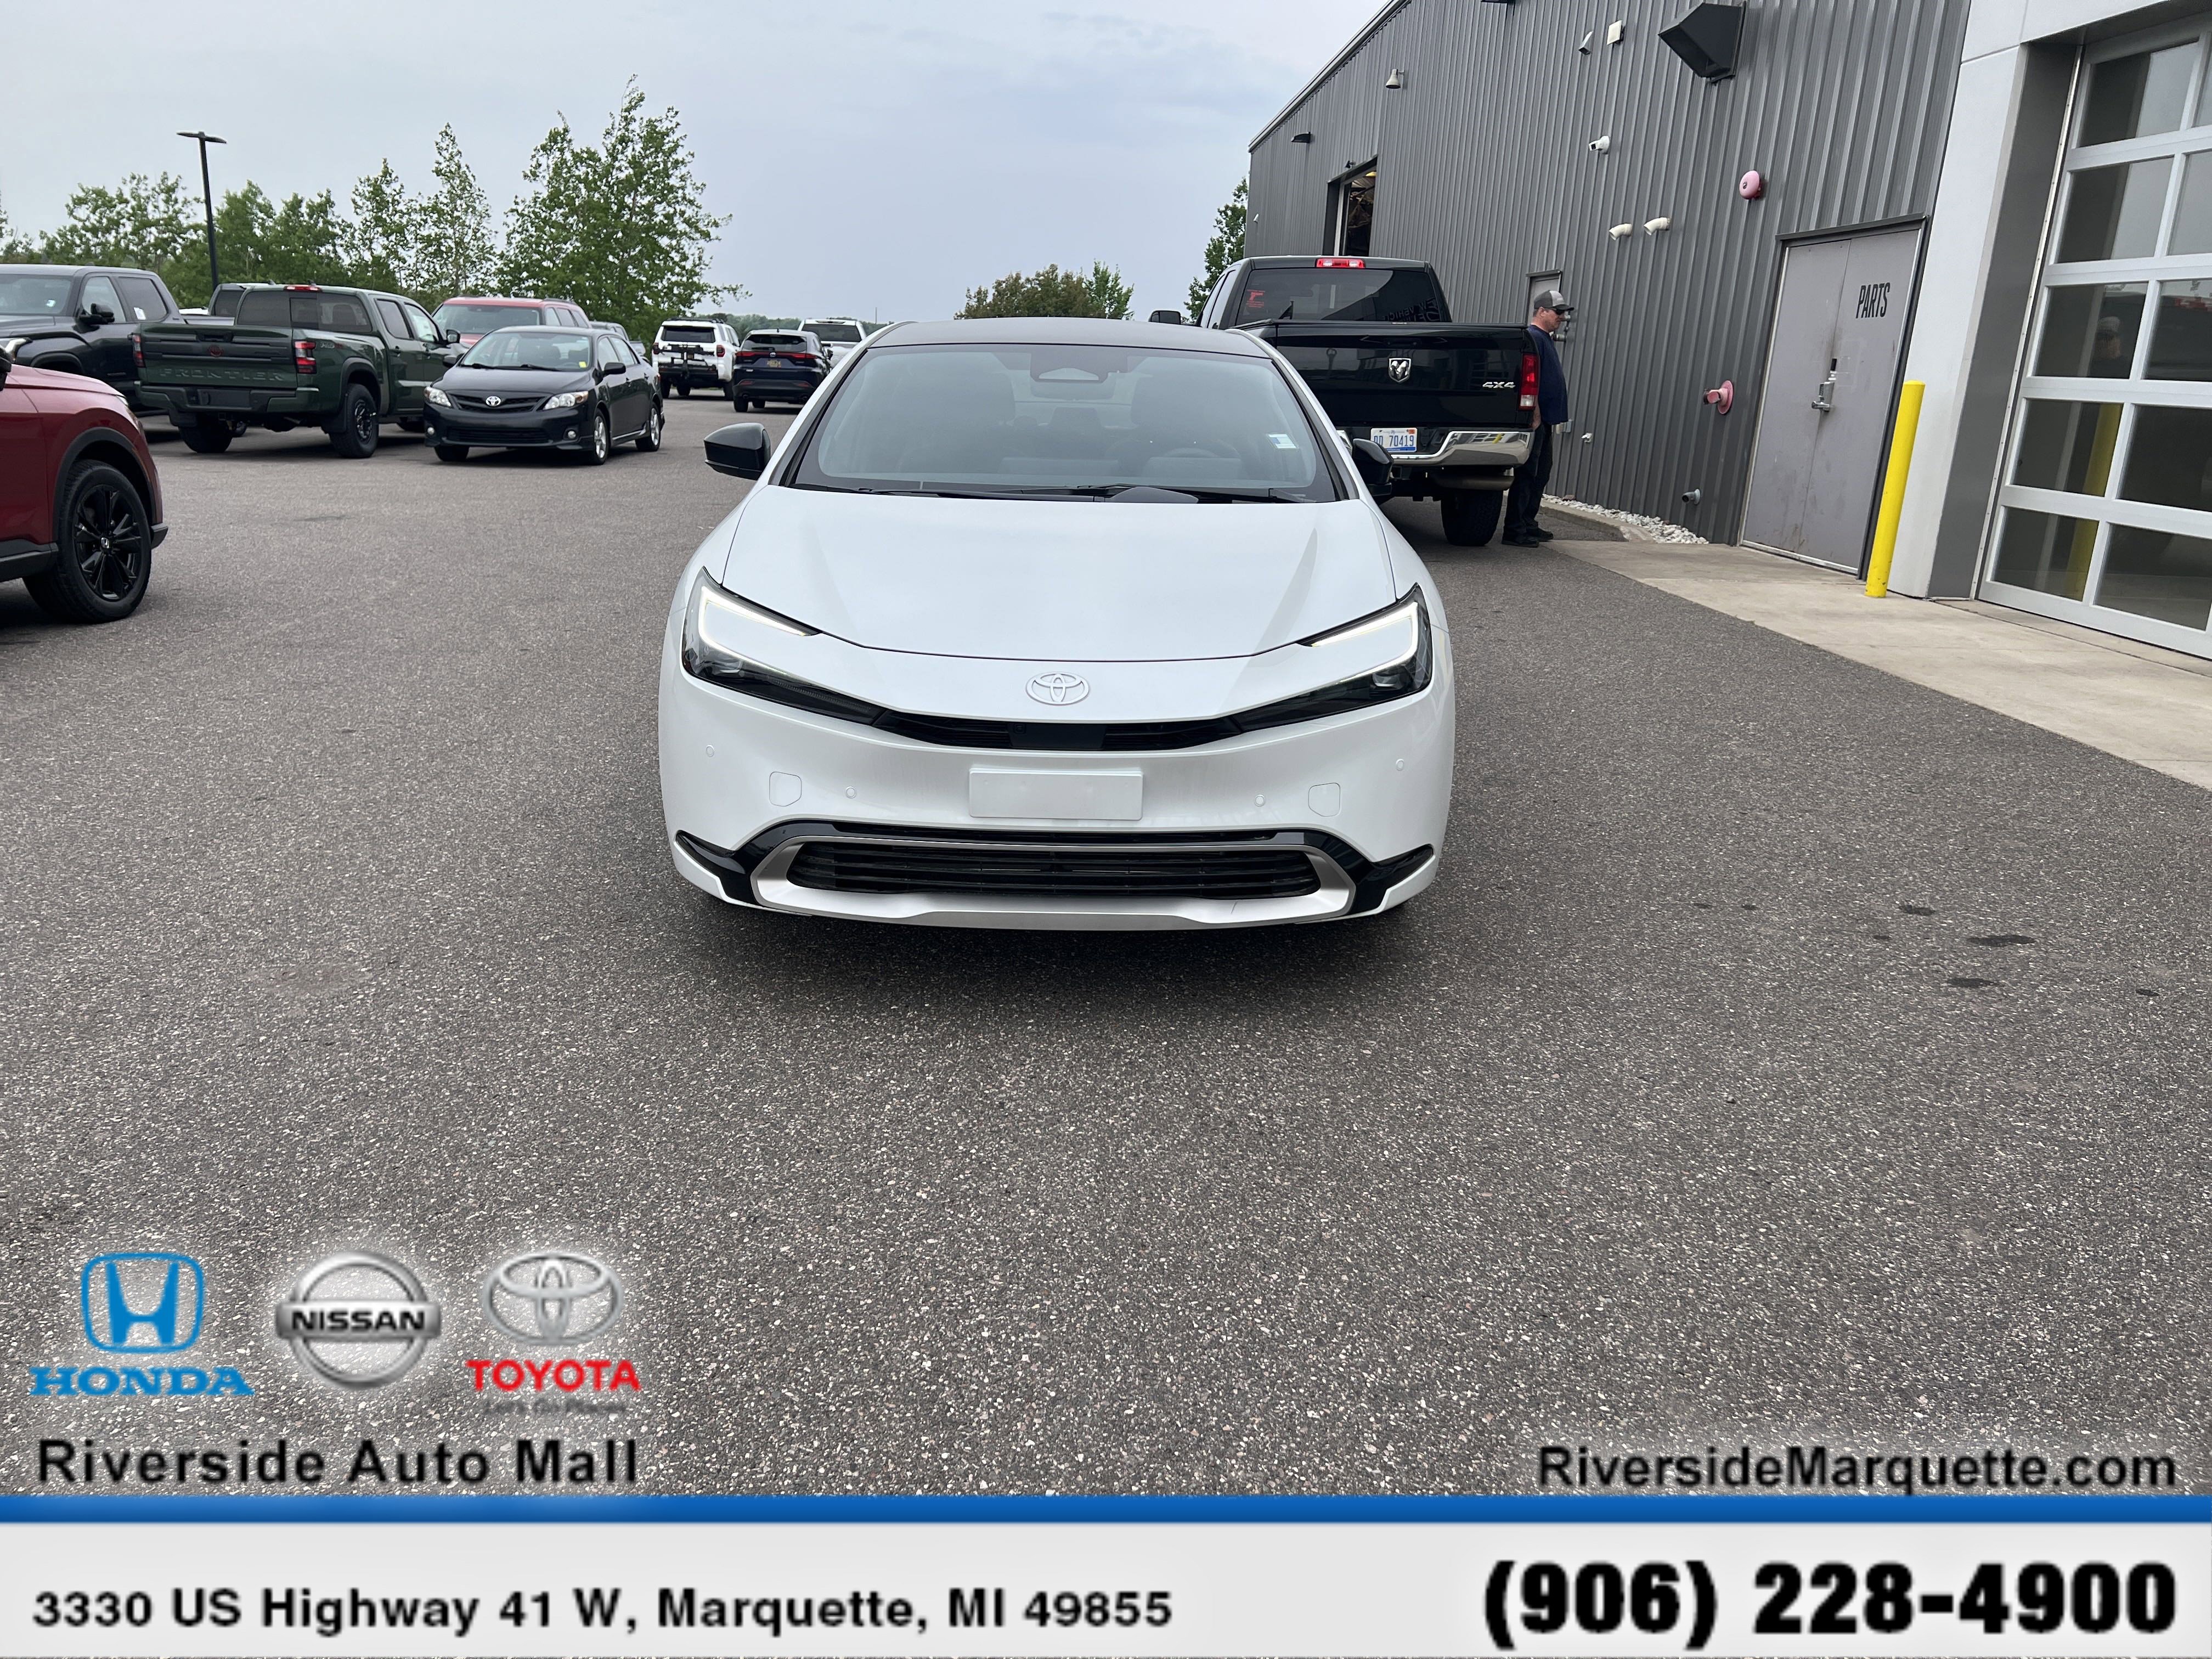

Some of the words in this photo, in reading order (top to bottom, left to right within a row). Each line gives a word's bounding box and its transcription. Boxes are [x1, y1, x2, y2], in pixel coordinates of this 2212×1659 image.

[1855, 282, 1891, 319] PARTS
[159, 367, 284, 381] FRONTIER
[1389, 435, 1414, 447] 70419
